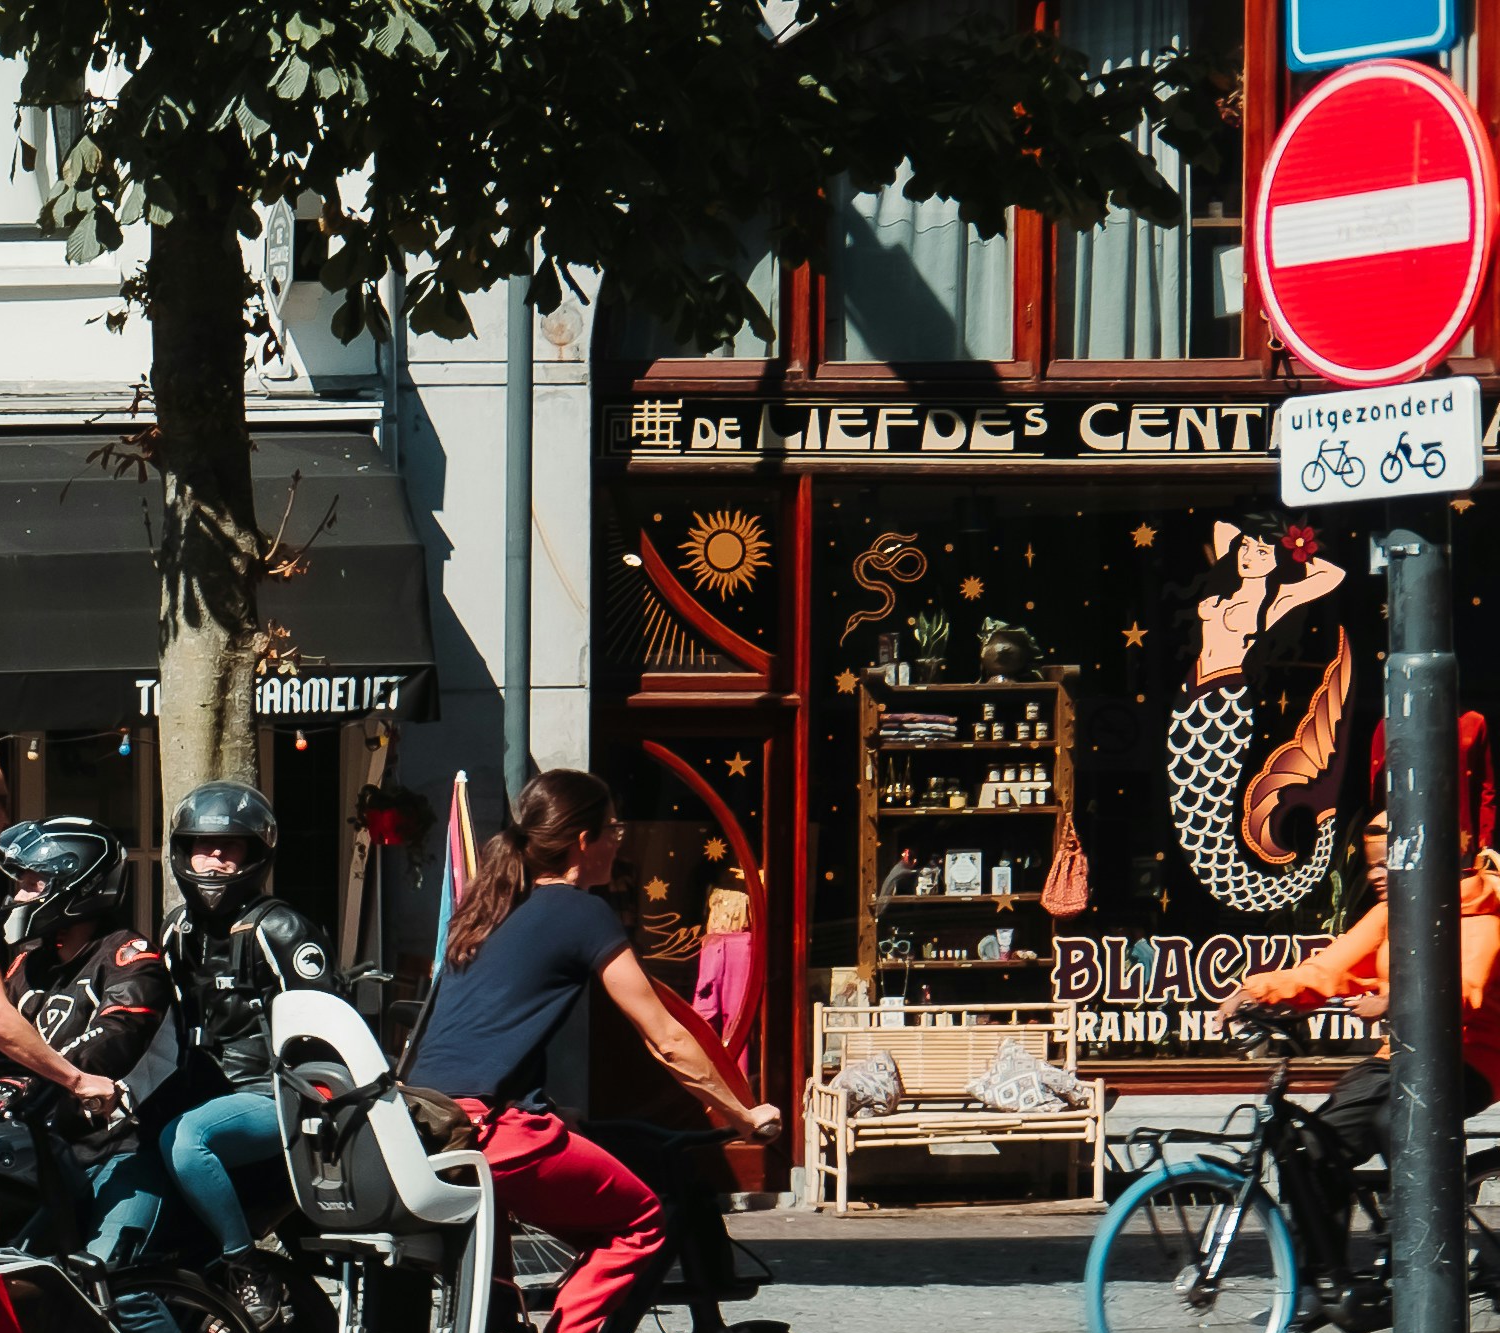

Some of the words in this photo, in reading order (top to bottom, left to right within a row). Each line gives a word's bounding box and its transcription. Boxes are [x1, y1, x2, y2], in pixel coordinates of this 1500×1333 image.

[690, 417, 742, 450] DE
[756, 403, 1049, 451] LIEFDES
[1079, 402, 1282, 451] CENT
[1290, 391, 1455, 433] uitgezonderd
[1051, 934, 1338, 1003] BLACK
[1179, 1010, 1250, 1042] NE
